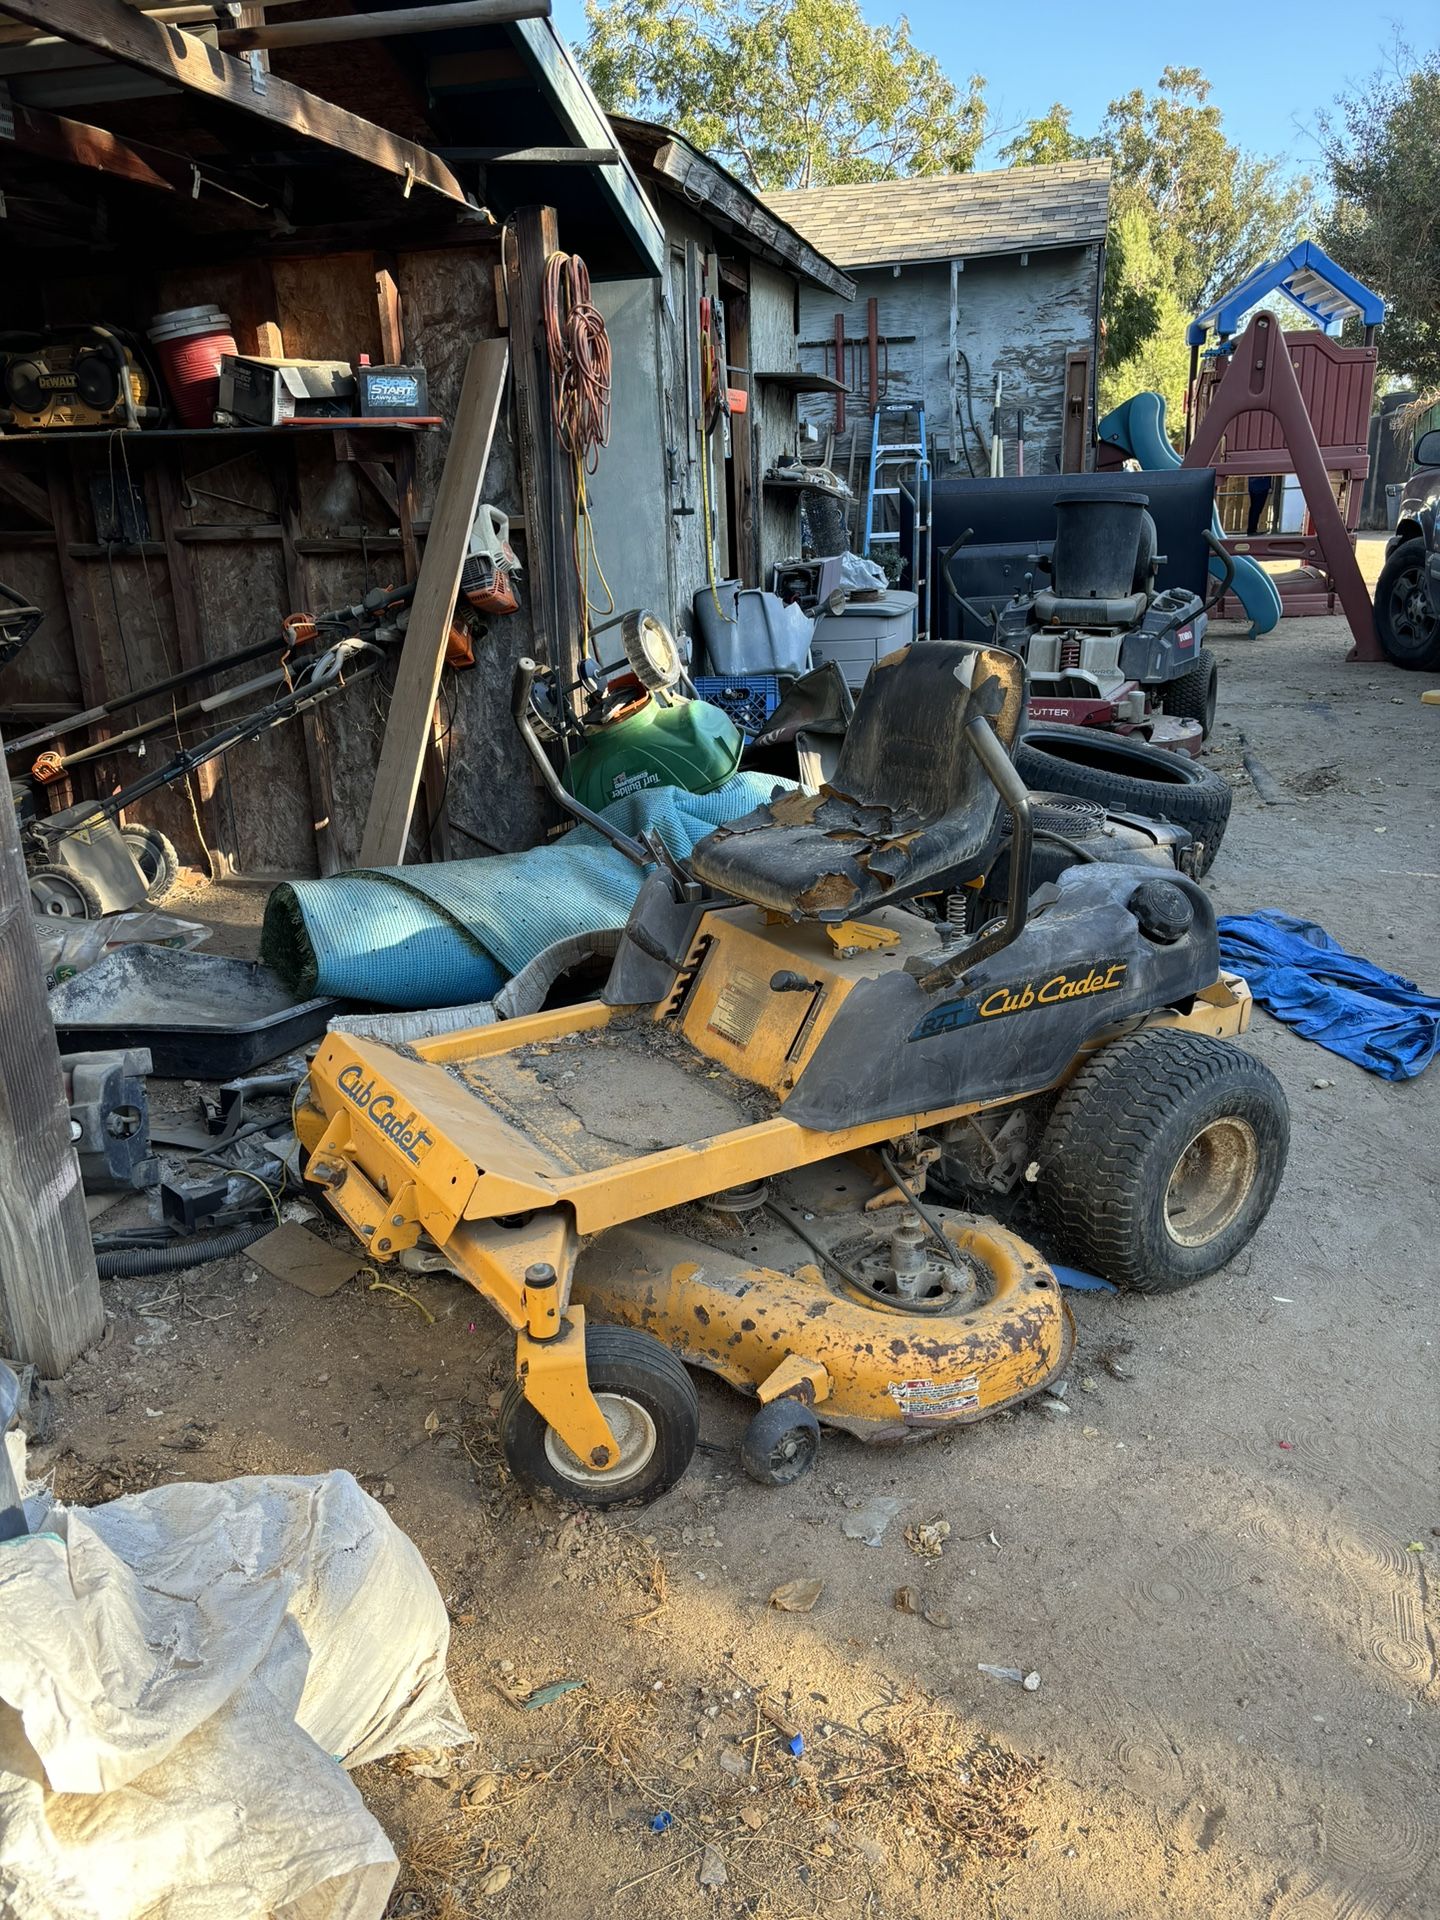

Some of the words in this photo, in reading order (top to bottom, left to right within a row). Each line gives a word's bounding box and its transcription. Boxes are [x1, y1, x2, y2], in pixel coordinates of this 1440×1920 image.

[371, 384, 415, 395] START
[612, 781, 642, 798] Builder
[643, 773, 661, 788] Turf
[979, 983, 1035, 1017] Cub
[1037, 964, 1127, 1003] Cadet
[921, 1009, 964, 1034] RZT
[337, 1065, 376, 1108] Cub
[367, 1095, 433, 1164] Cadet
